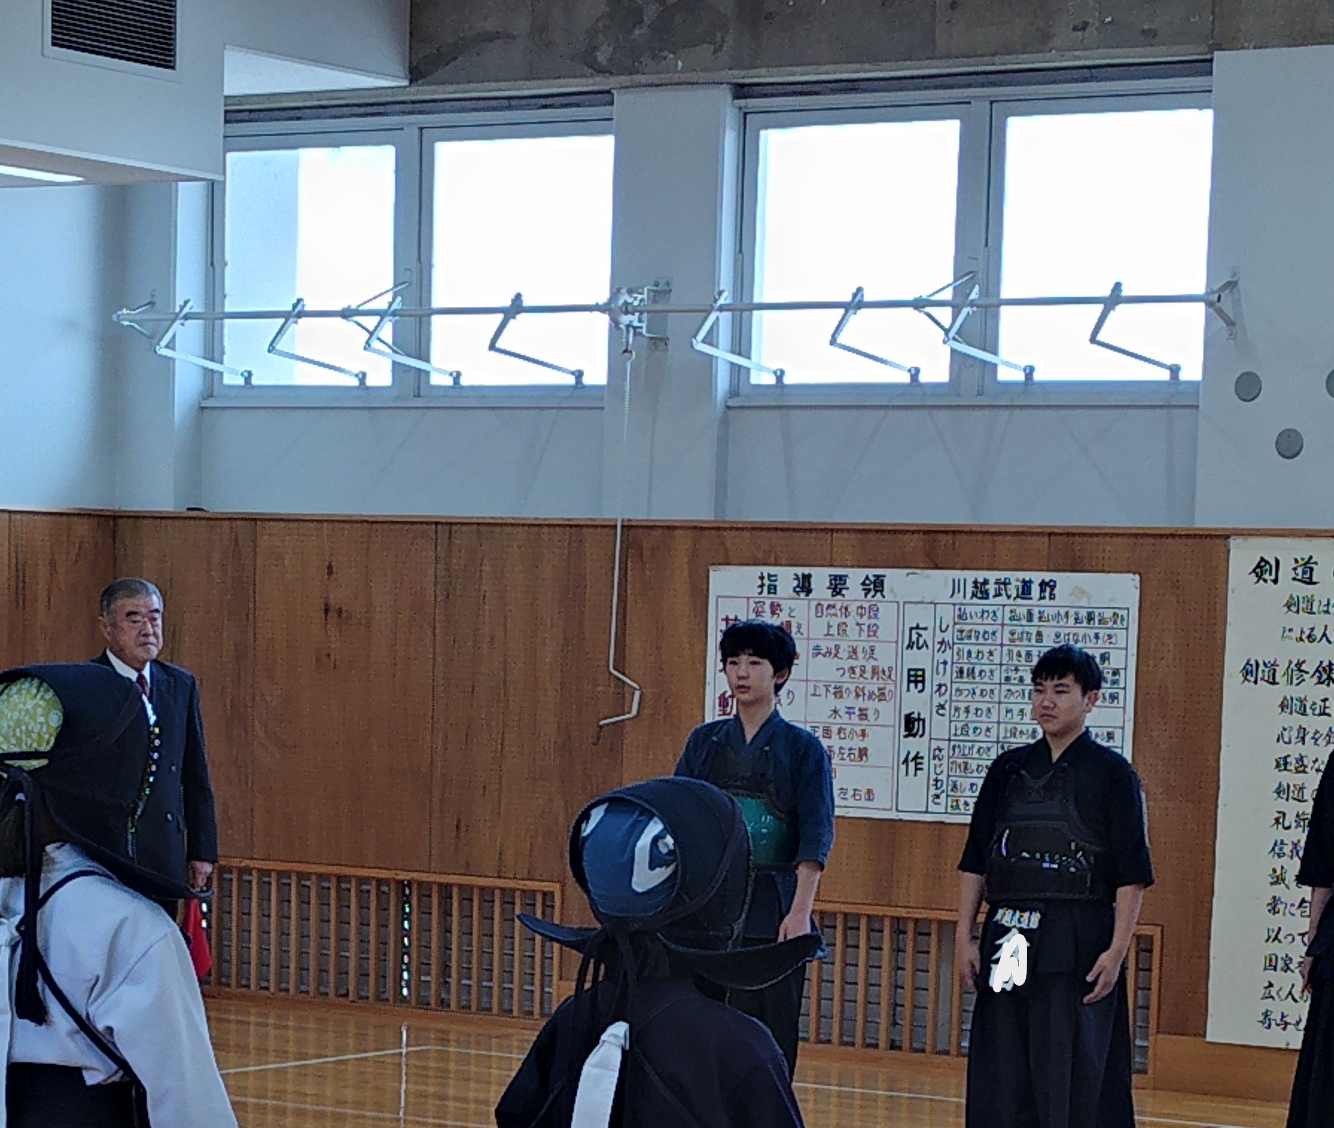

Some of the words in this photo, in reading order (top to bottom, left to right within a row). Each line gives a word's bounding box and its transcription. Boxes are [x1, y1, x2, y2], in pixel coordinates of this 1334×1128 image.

[758, 572, 887, 599] 指導要領
[949, 577, 1057, 601] 川越武道館
[933, 615, 953, 718] しかけわざ
[903, 622, 930, 778] 応用動作
[931, 745, 947, 806] 応じわざ
